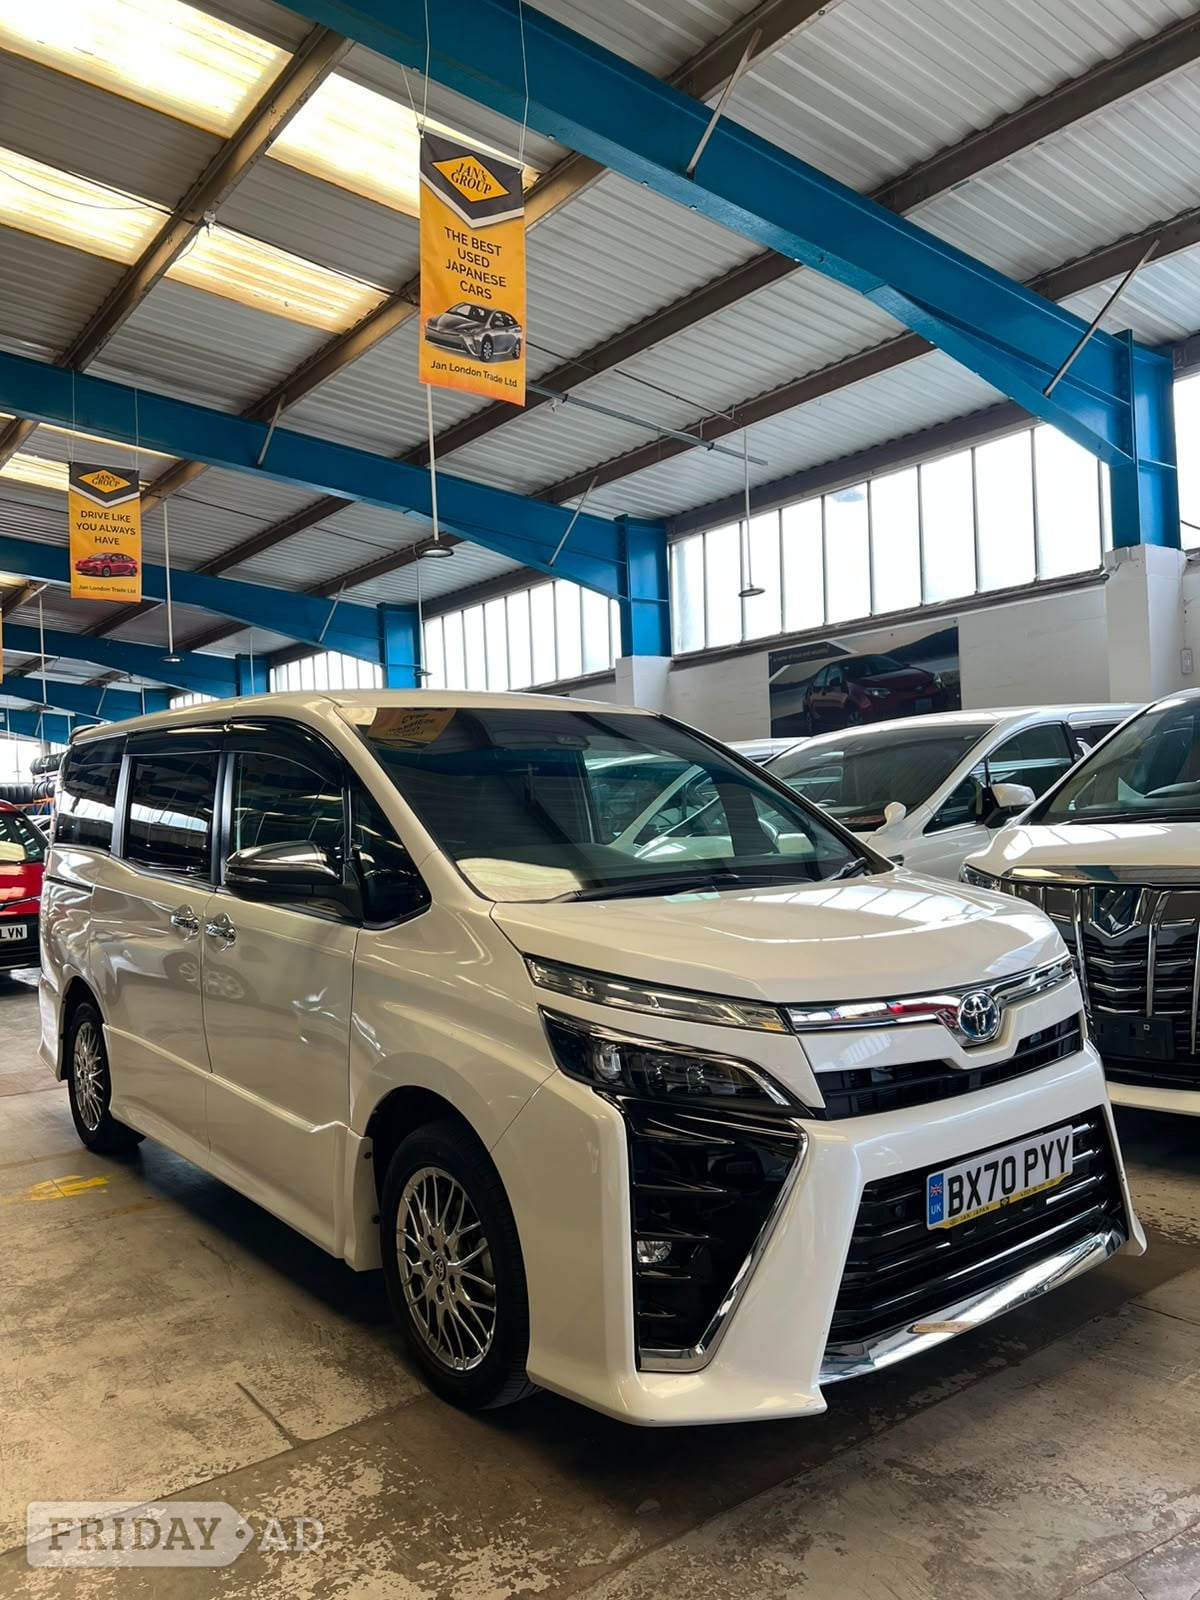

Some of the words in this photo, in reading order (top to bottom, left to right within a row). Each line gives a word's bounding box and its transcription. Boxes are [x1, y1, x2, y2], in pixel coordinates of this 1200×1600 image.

[451, 171, 492, 193] GROUP
[444, 226, 468, 246] THE
[471, 237, 502, 256] BEST
[457, 247, 490, 268] USED
[445, 258, 506, 288] JAPANESE
[460, 280, 492, 299] CARS
[430, 360, 447, 370] Jan
[449, 362, 481, 377] London
[483, 370, 503, 384] Trade
[504, 377, 517, 387] Ltd
[91, 479, 120, 487] GROUP
[80, 510, 110, 520] DRIVE
[112, 513, 131, 523] LIKE
[76, 522, 97, 531] YOU
[99, 525, 136, 535] ALWAYS
[94, 535, 120, 545] HAVE
[947, 1155, 1016, 1218] BX70
[1024, 1135, 1069, 1188] PYY
[930, 1202, 941, 1215] UK
